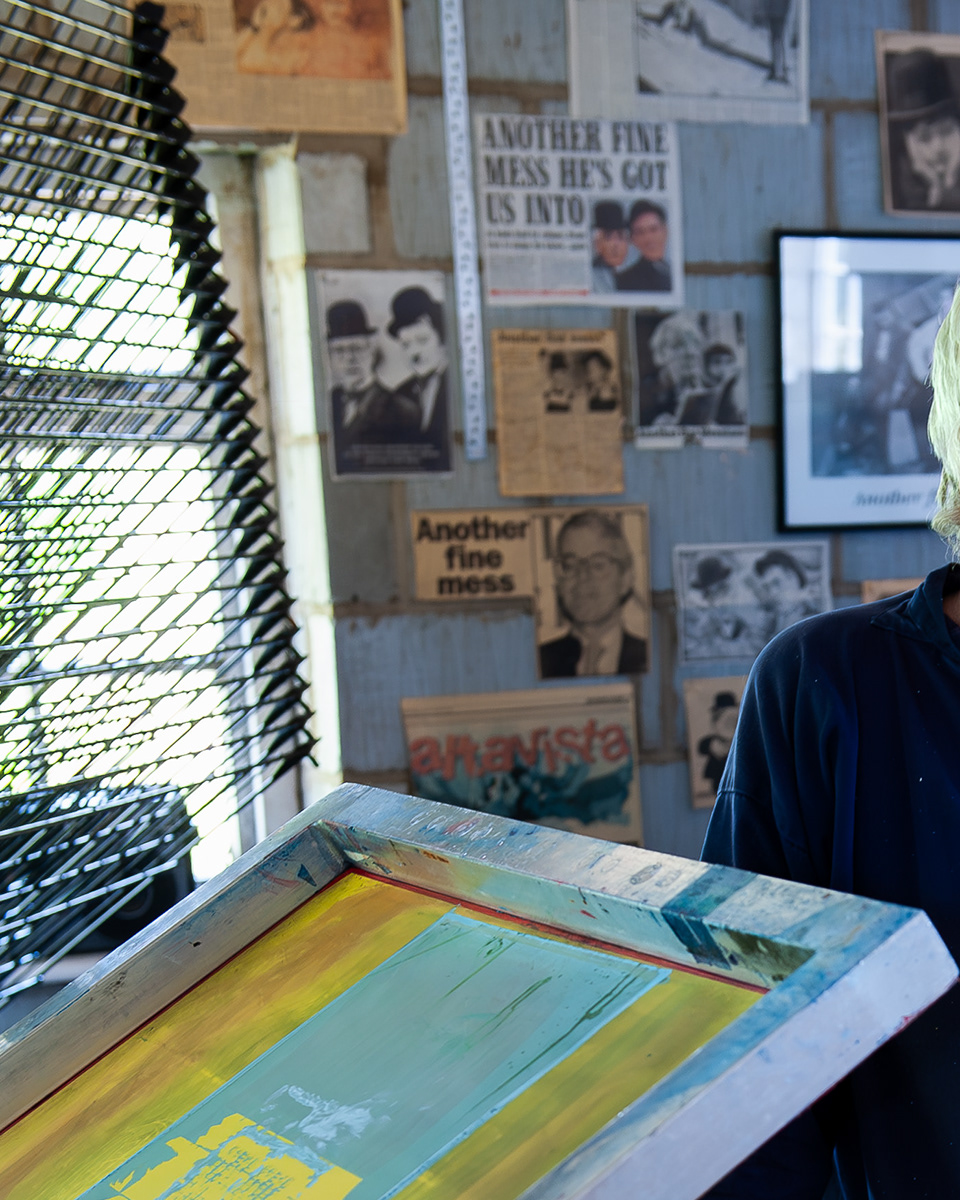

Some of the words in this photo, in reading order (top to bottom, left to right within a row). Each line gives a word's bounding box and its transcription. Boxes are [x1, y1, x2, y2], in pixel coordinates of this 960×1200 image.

[485, 118, 601, 151] ANOTHER
[612, 122, 669, 153] FINE
[485, 154, 549, 187] MESS
[559, 156, 613, 189] HE'S
[621, 160, 668, 191] GOT
[486, 192, 516, 224] US
[527, 193, 585, 225] INTO
[416, 515, 529, 542] Another
[443, 544, 503, 570] fine
[437, 573, 515, 595] mess
